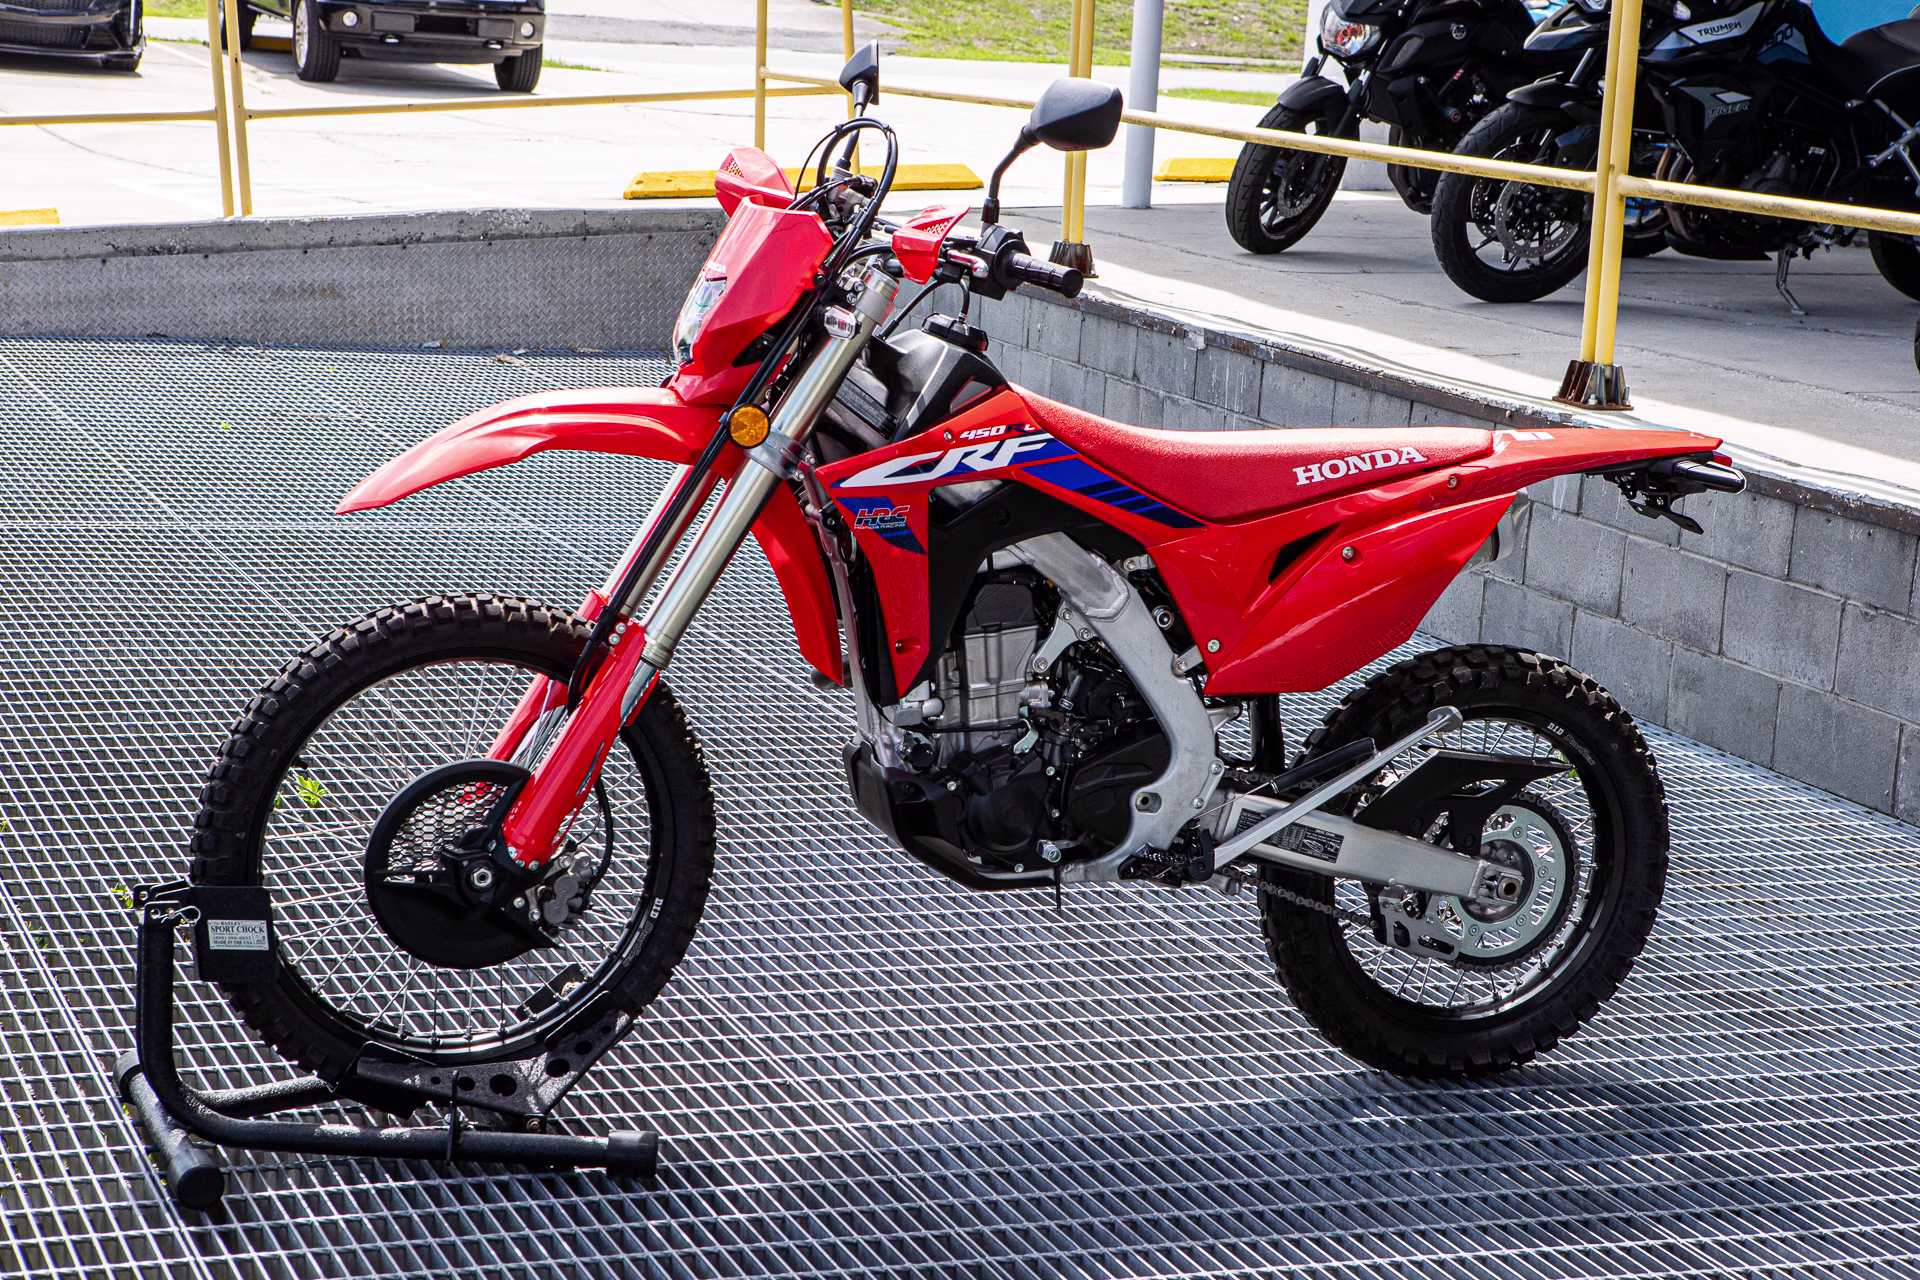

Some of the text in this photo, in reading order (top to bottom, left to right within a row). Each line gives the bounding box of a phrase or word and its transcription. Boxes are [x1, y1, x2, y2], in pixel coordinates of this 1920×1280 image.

[1697, 21, 1742, 37] TRIUMPH
[1707, 101, 1749, 118] TIGER
[960, 423, 1035, 440] 450RL
[840, 433, 1054, 488] CRF
[1292, 447, 1427, 486] HONDA
[854, 505, 910, 526] HRC
[210, 925, 235, 933] SPORT
[236, 925, 265, 934] CHOCK
